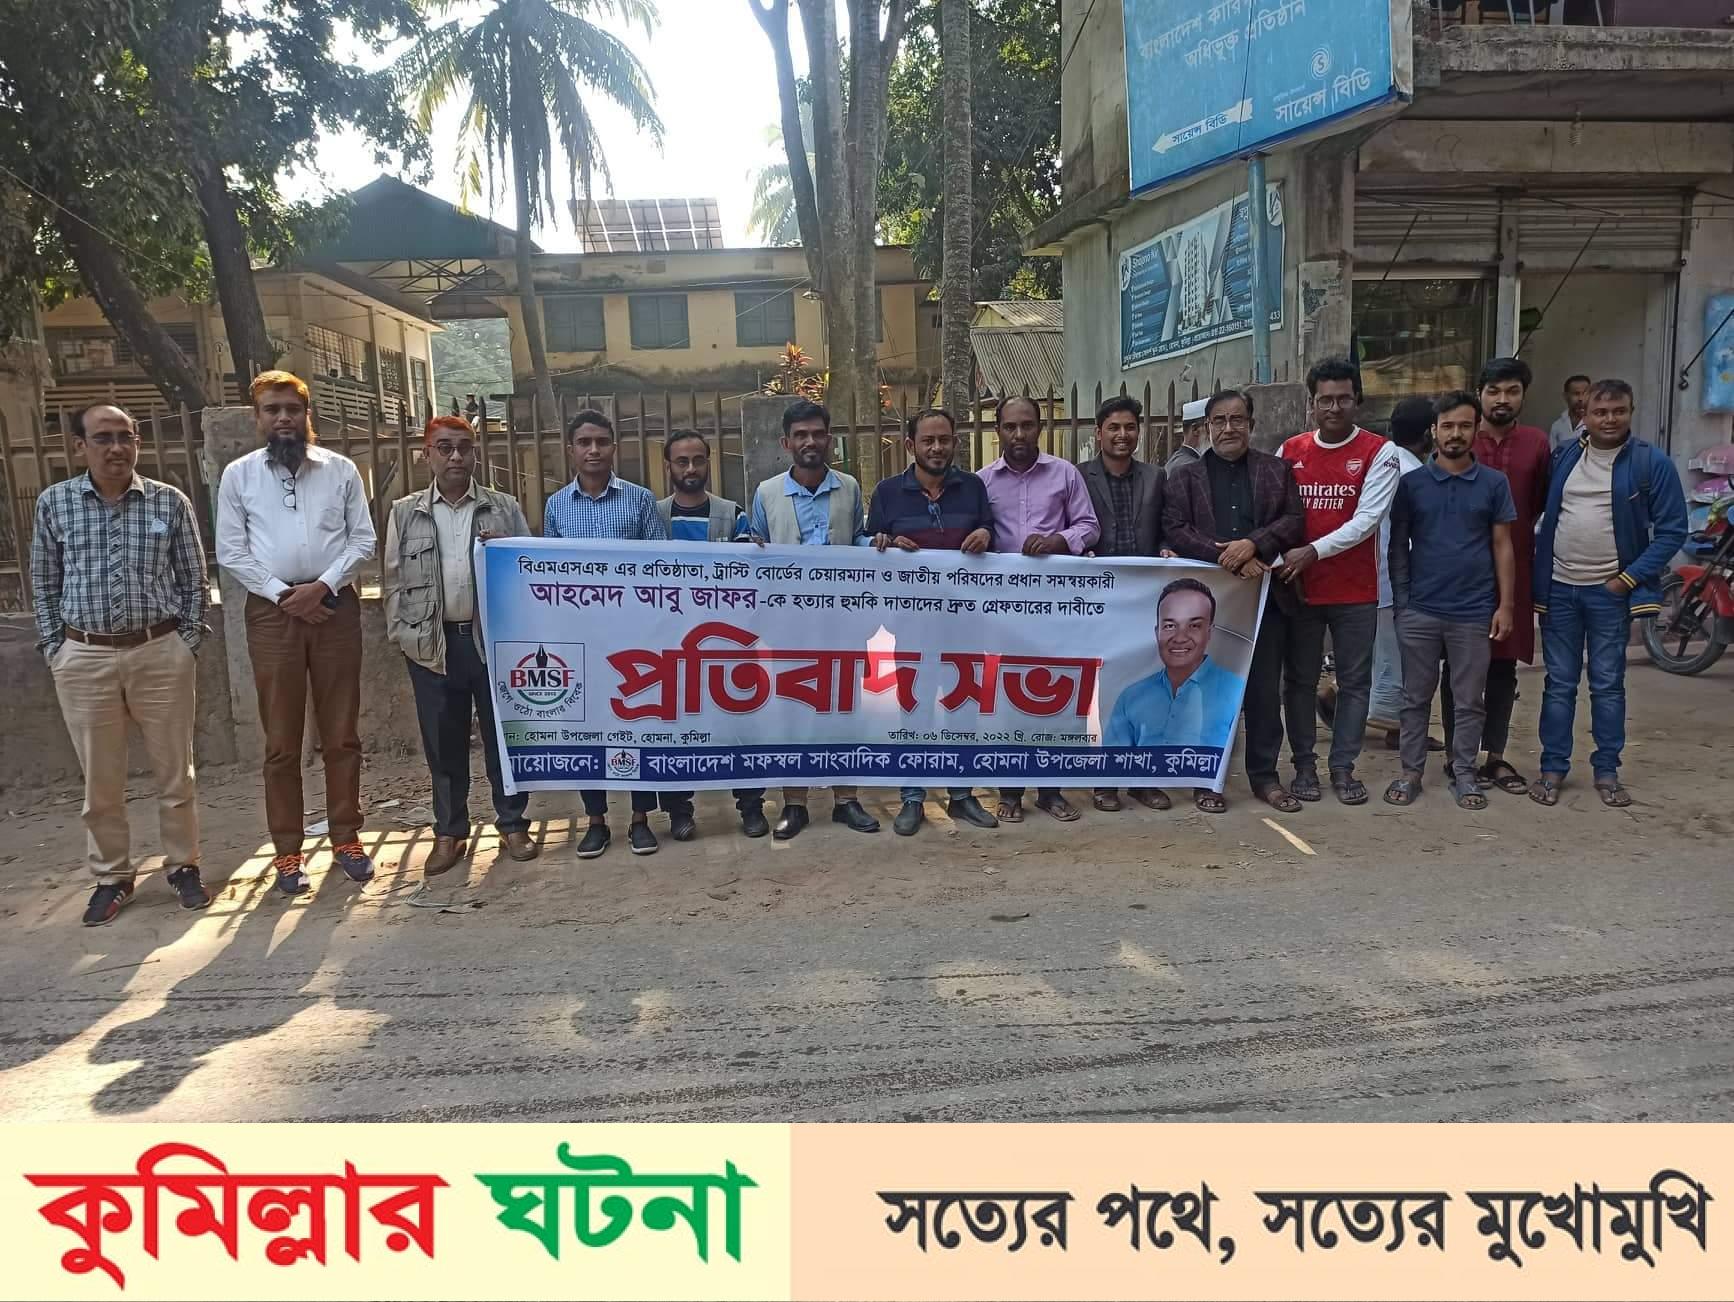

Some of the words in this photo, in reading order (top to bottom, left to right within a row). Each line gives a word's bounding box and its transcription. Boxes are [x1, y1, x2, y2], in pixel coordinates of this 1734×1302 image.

[1333, 67, 1371, 102] বিডি
[1205, 112, 1228, 131] বিডি
[1299, 482, 1356, 497] mirates
[1312, 497, 1344, 510] BETTER
[518, 556, 608, 575] বিএমএসএফ
[614, 561, 636, 576] এর
[642, 559, 709, 581] প্রতিষ্ঠাতা,
[713, 561, 749, 580] ট্রাস্টি
[755, 562, 802, 581] বোর্ডের
[808, 567, 874, 583] চেয়ারম্যান
[881, 571, 893, 582] ও
[897, 566, 940, 585] জাতীয়
[946, 568, 1003, 586] পরিষদের
[1008, 574, 1041, 589] প্রধান
[529, 584, 625, 610] আহমেদ
[632, 585, 684, 615] আবু
[792, 593, 834, 611] হত্যার
[840, 591, 878, 611] হুমকি
[884, 595, 942, 612] দাতাদের
[948, 599, 976, 615] দ্রুত
[982, 599, 1051, 616] গ্রেফতারের
[1057, 597, 1105, 617] দাবীতে
[510, 670, 575, 688] BMSF
[606, 621, 923, 721] প্রতিবাদ
[940, 650, 1104, 719] সভা
[504, 732, 519, 741] ান:
[525, 731, 557, 742] হোমনা
[561, 729, 603, 742] উপজেলা
[607, 730, 637, 744] গেইট,
[640, 732, 676, 744] হোমনা,
[680, 729, 711, 745] কুমিল্লা
[888, 730, 919, 741] তারিখ:
[923, 732, 938, 741] ০৬
[983, 732, 1010, 742] ২০২২
[646, 753, 735, 775] বাংলাদেশ
[741, 752, 802, 772] মফস্বল
[808, 745, 891, 771] সাংবাদিক
[899, 751, 965, 774] ফোরাম,
[973, 751, 1029, 772] হোমনা
[1035, 747, 1109, 771] উপজেলা
[1114, 751, 1157, 774] শাখা,
[1165, 747, 1221, 775] কুমিল্লা
